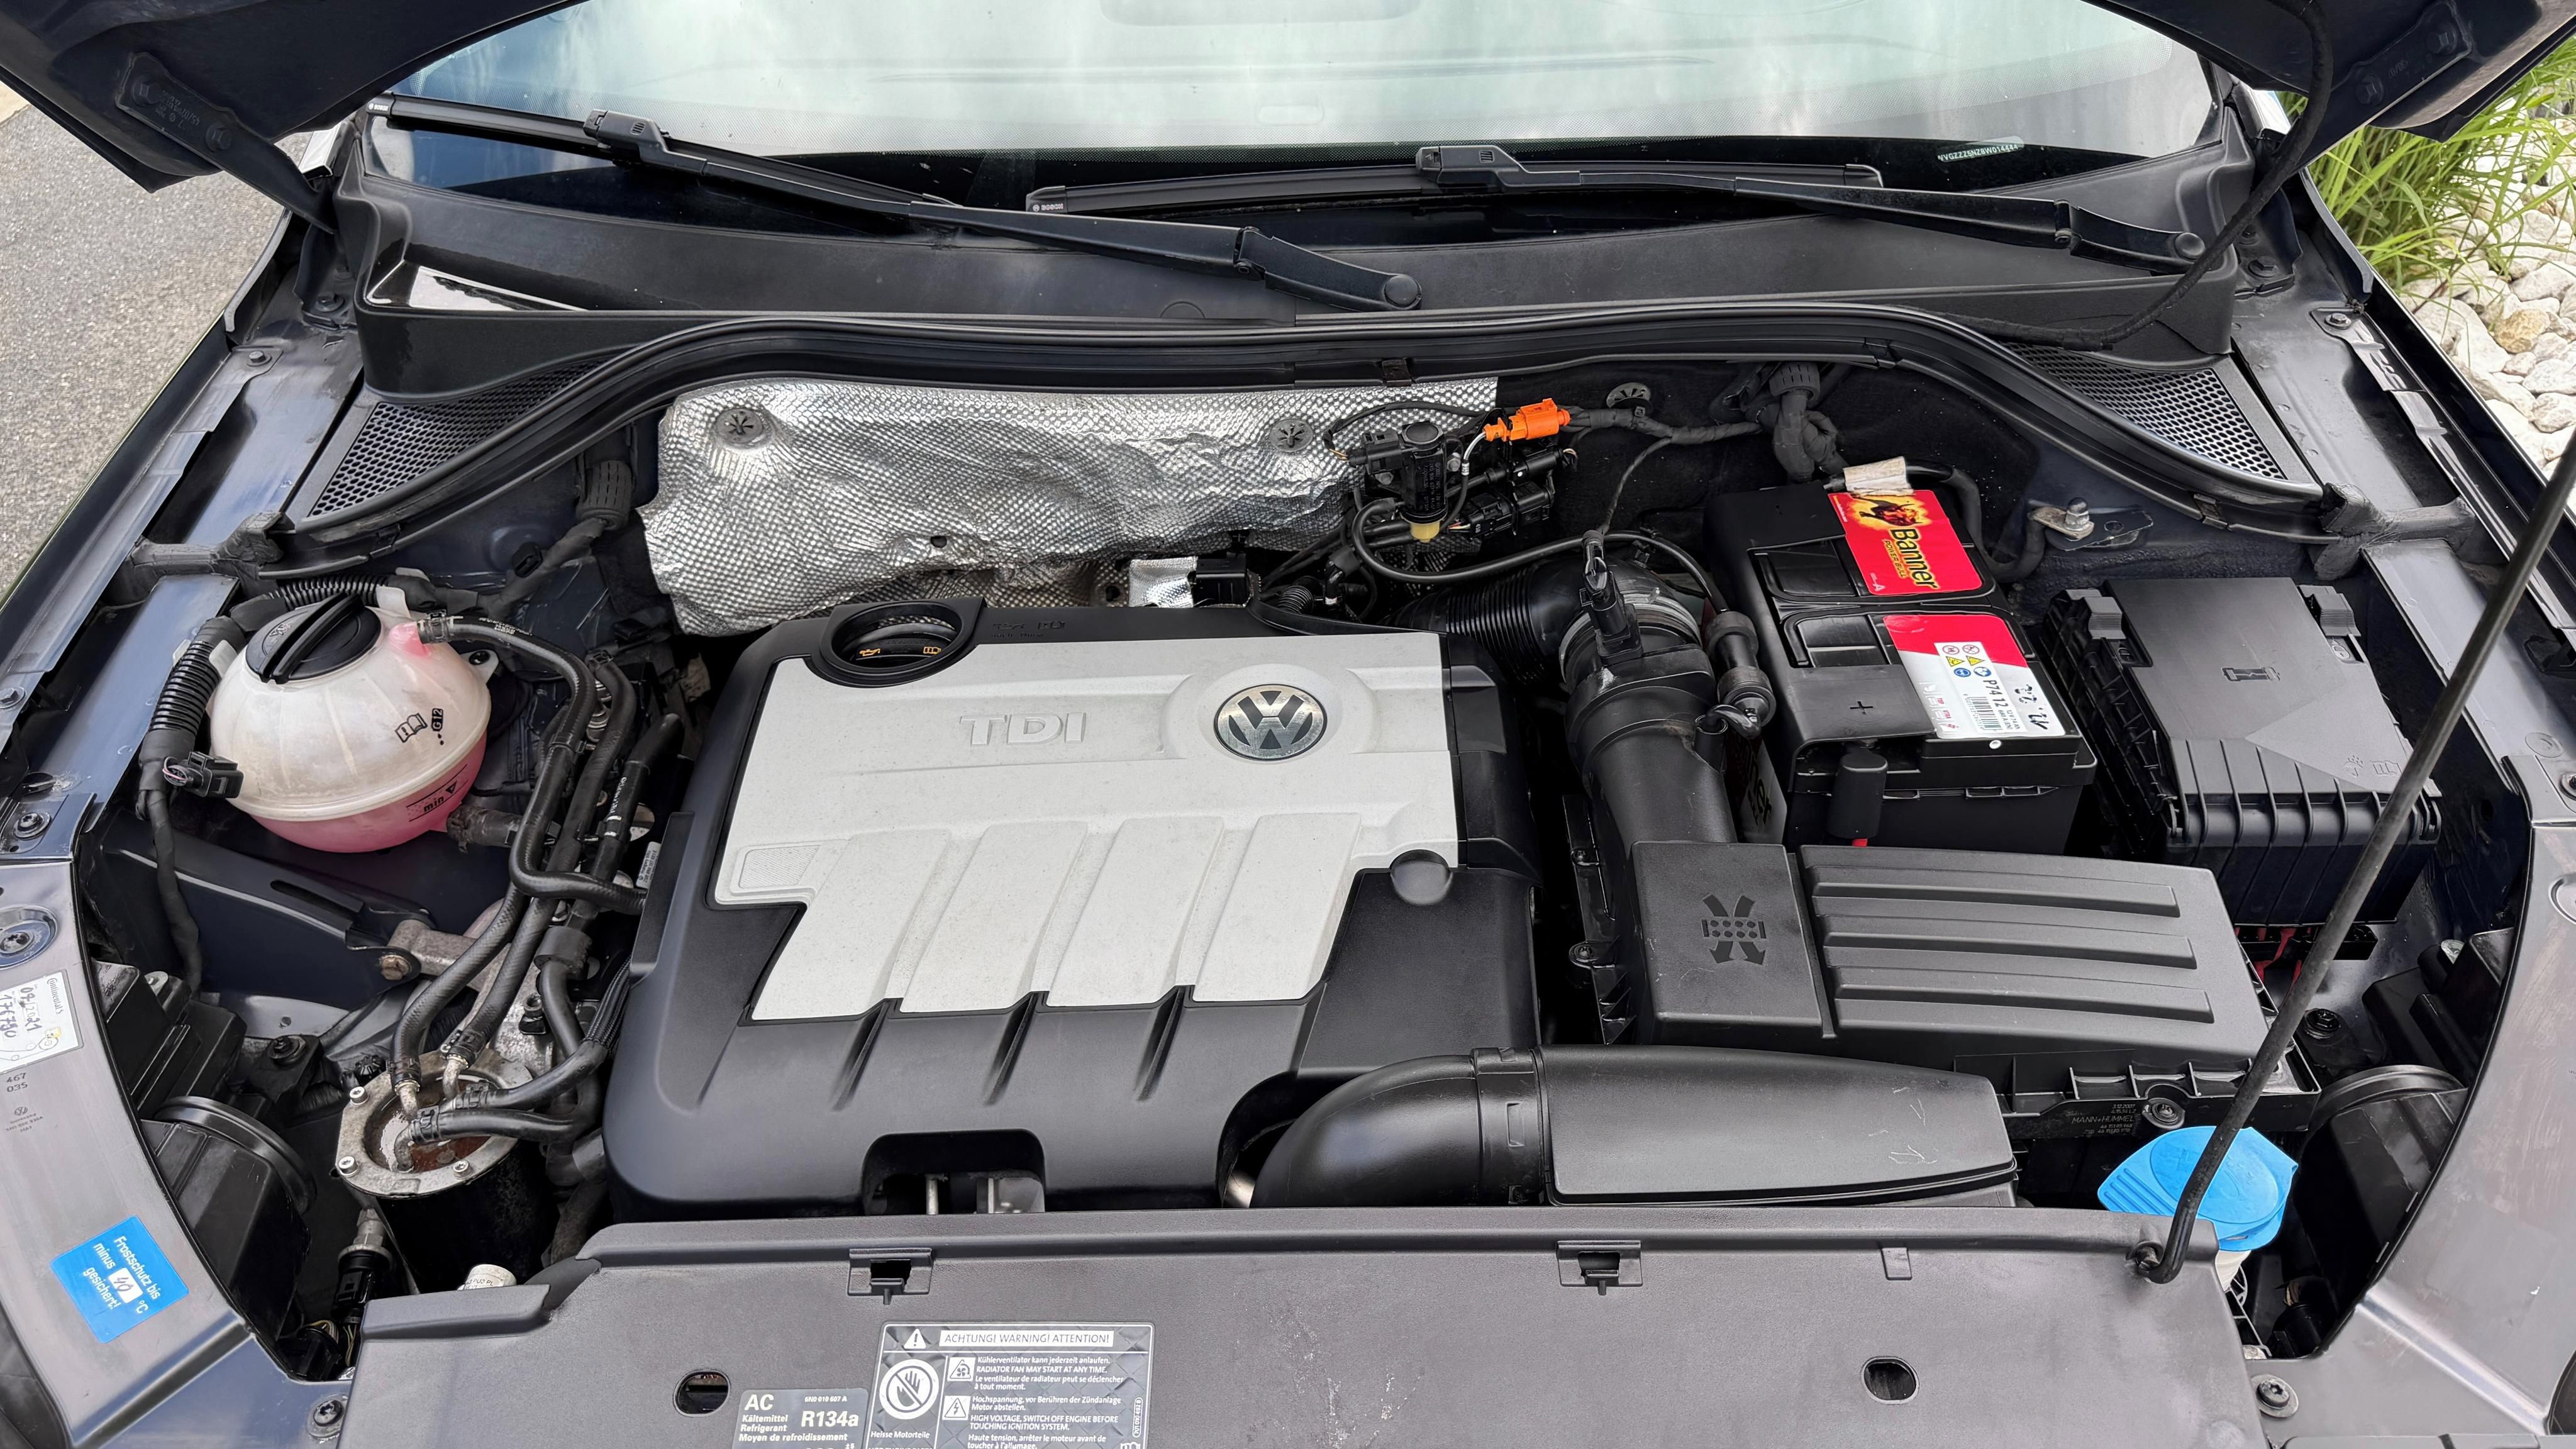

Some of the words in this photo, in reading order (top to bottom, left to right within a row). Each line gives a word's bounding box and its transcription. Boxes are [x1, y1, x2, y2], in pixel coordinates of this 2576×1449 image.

[1884, 540, 1899, 562] POWER
[1895, 562, 1907, 578] BULL
[1889, 528, 1939, 589] Banner
[1983, 679, 2004, 696] P74
[1992, 699, 2009, 708] 12
[432, 708, 443, 731] G12
[958, 711, 1087, 745] TDI
[424, 796, 444, 813] min
[47, 978, 61, 1012] Continental
[6, 1072, 26, 1082] 467
[2072, 1114, 2135, 1124] MANN+HUMMEL
[93, 1243, 116, 1270] minus
[114, 1235, 152, 1287] Frostschutz
[146, 1283, 161, 1300] bis
[82, 1267, 121, 1310] gesichert!
[135, 1300, 149, 1314] °C
[1053, 1334, 1109, 1343] ATTENTION!
[977, 1356, 1030, 1364] Kühlerventilator
[1048, 1357, 1078, 1365] jederzeit
[976, 1365, 1009, 1374] RADIATOR
[1011, 1365, 1024, 1374] FAN
[1026, 1365, 1042, 1374] MAY
[1042, 1365, 1062, 1374] START
[1063, 1365, 1073, 1374] AT
[1073, 1365, 1088, 1374] ANY
[1089, 1365, 1108, 1374] TIME.
[1087, 1375, 1124, 1383] déclencher
[744, 1394, 774, 1411] AC
[973, 1396, 1024, 1404] Hochspannung,
[1082, 1397, 1121, 1405] Zündanlage
[742, 1414, 788, 1423] Kältemittel
[801, 1410, 859, 1428] R134a
[740, 1424, 787, 1433] Refrigerant
[739, 1433, 767, 1443] Moyen
[769, 1433, 780, 1441] de
[782, 1433, 848, 1441] refroidissement
